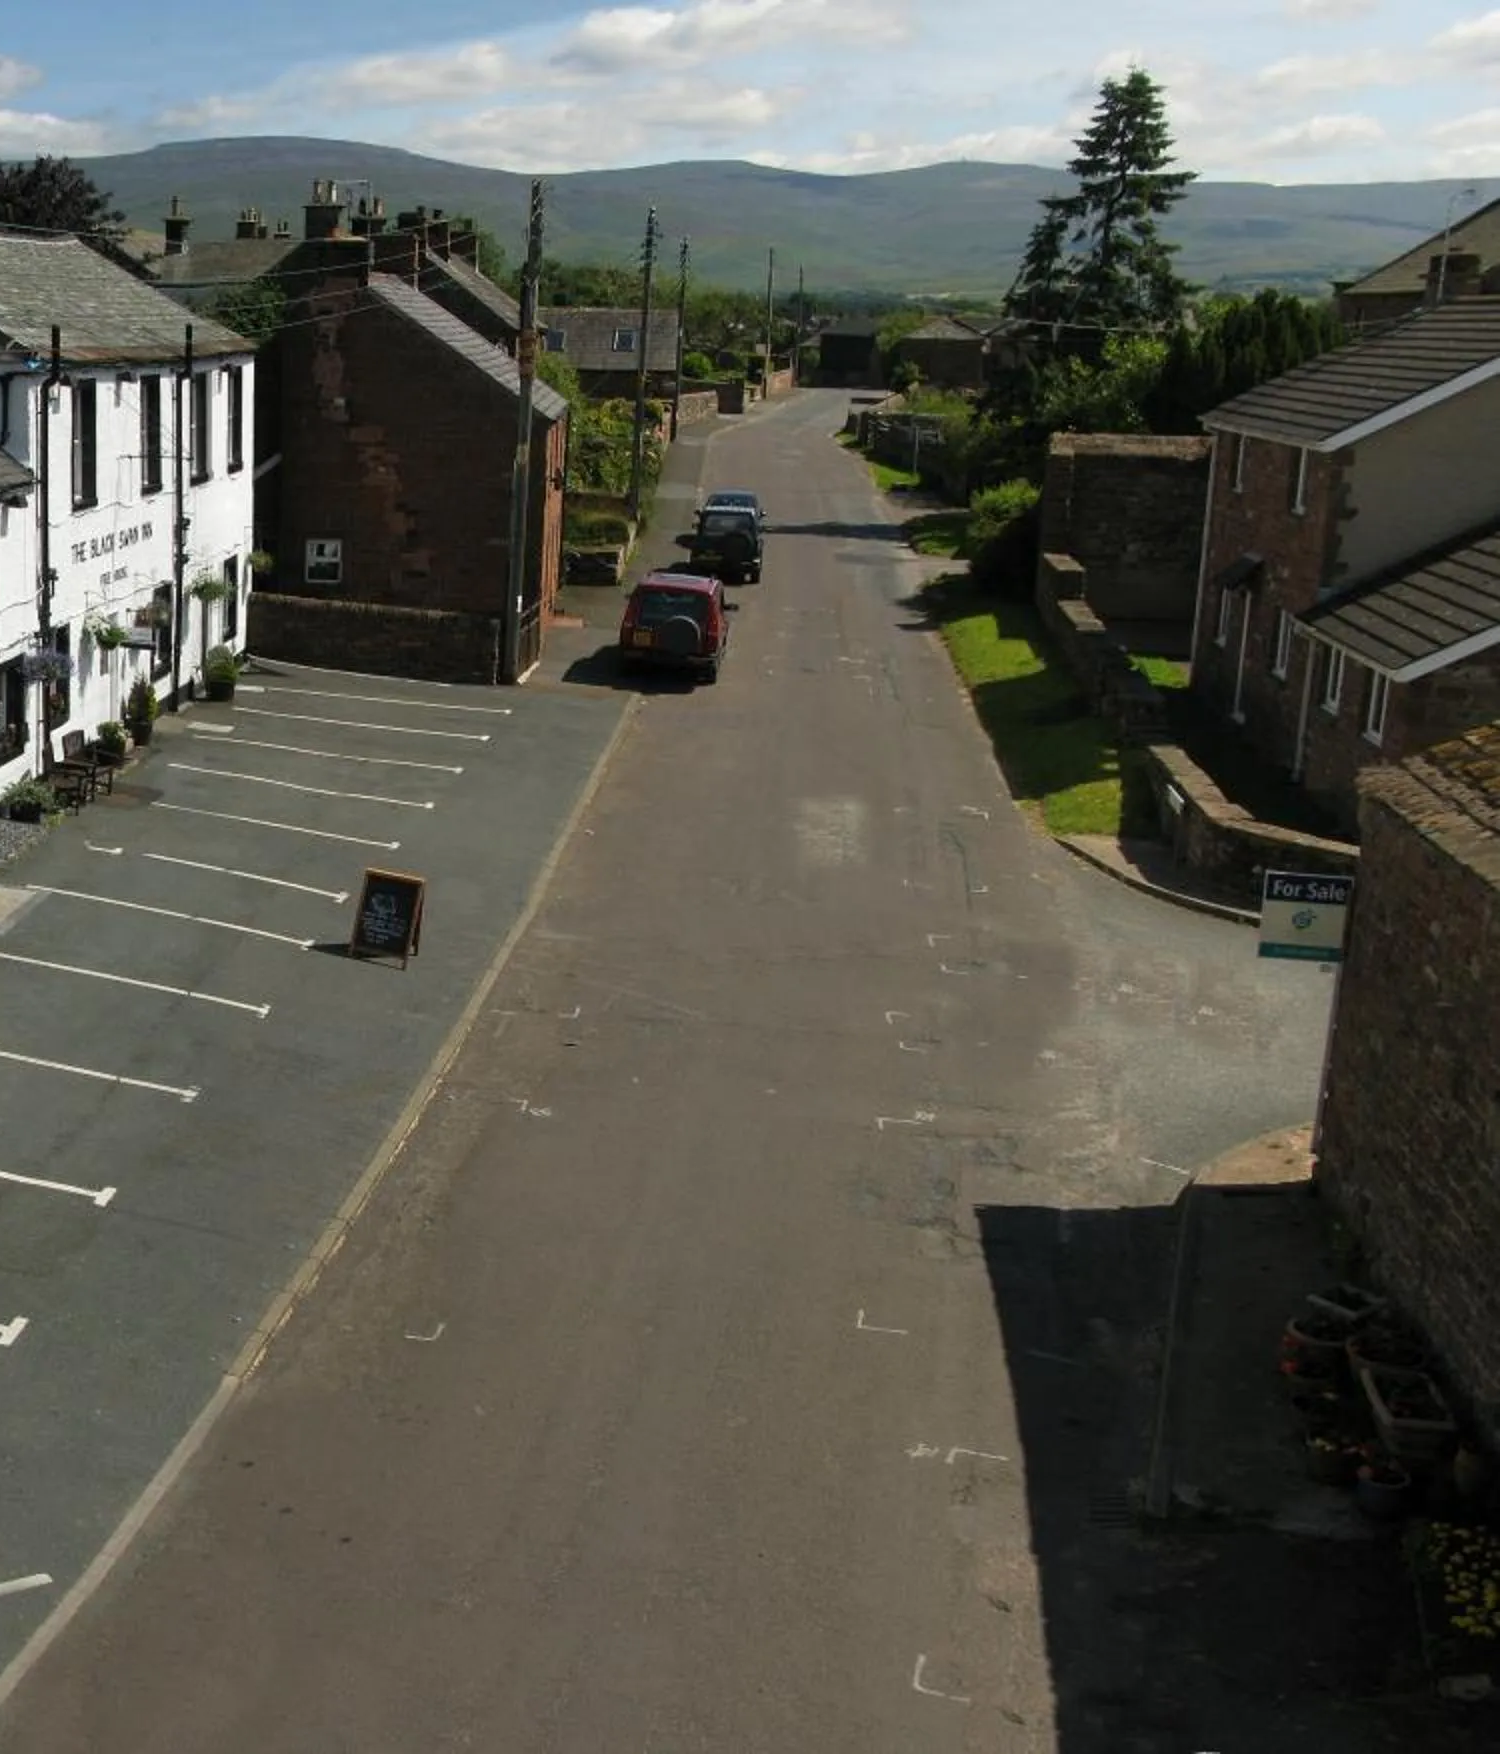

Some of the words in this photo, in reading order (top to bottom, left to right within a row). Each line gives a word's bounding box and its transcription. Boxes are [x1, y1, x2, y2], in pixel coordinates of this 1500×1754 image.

[71, 540, 87, 565] THE
[90, 533, 115, 560] BLACK
[1272, 879, 1303, 898] For
[1306, 881, 1346, 901] Sale
